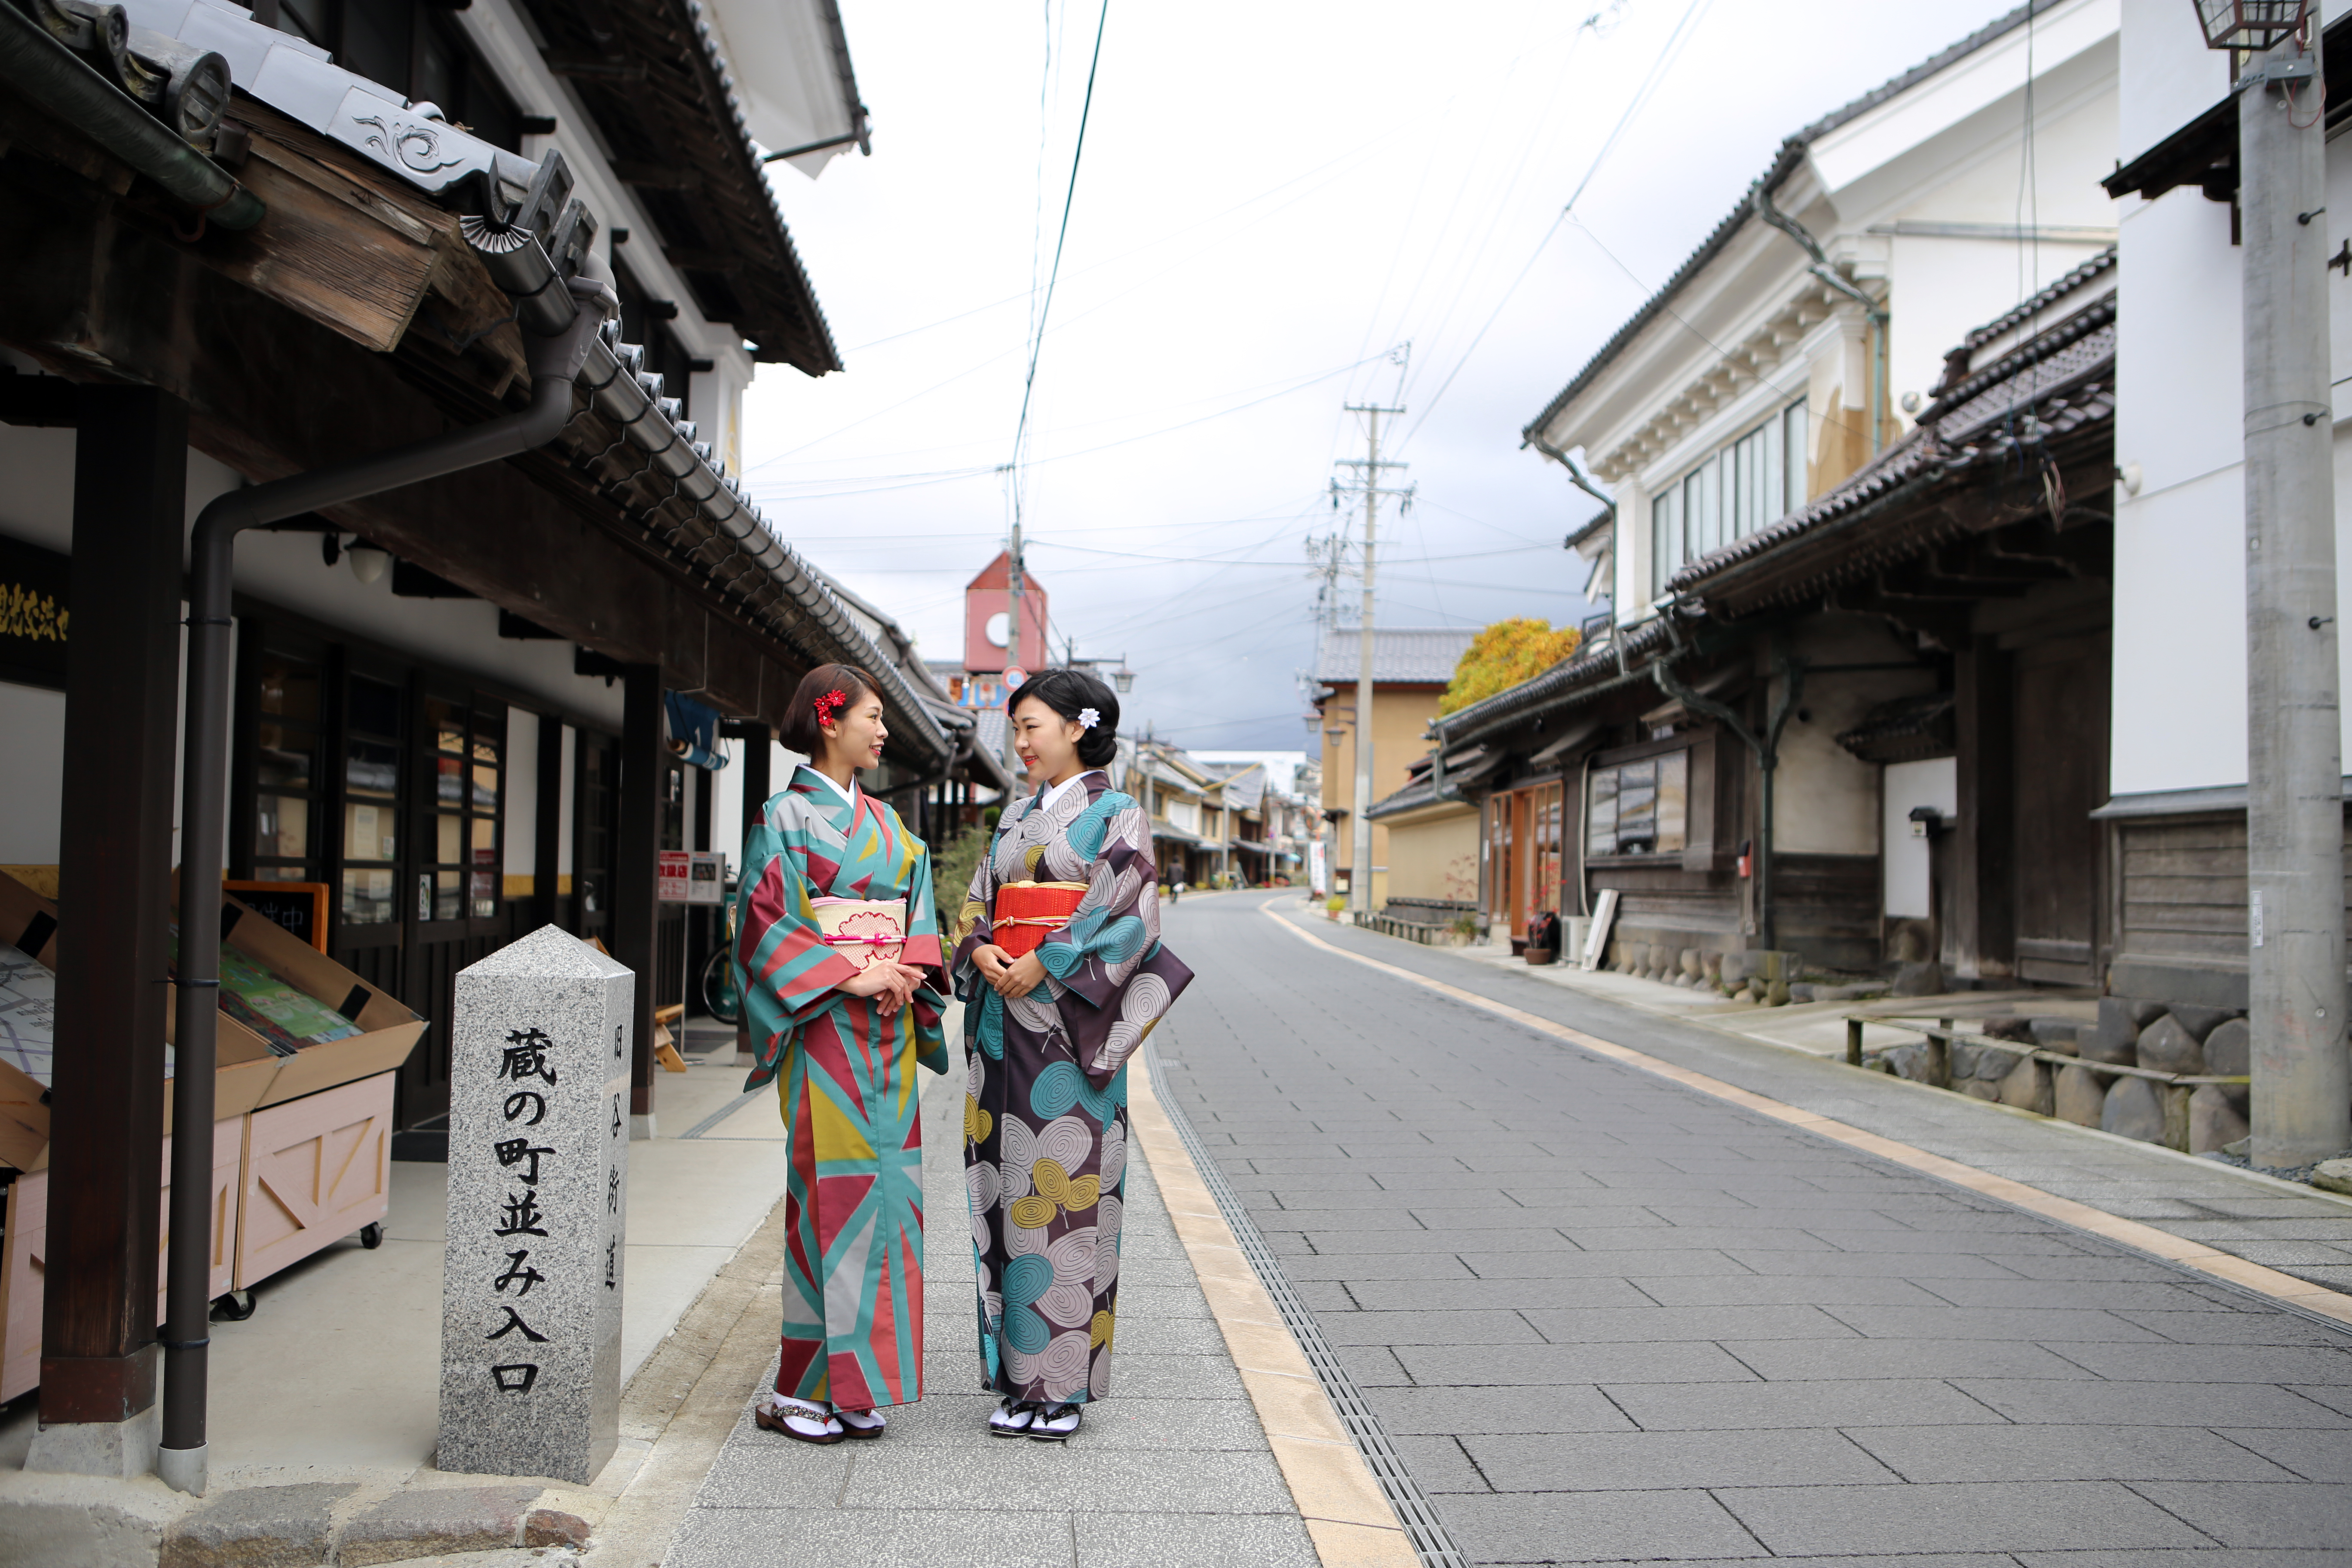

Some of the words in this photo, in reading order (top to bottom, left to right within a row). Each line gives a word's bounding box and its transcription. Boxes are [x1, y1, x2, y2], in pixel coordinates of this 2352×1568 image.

[1009, 673, 1023, 683] 40
[484, 1027, 557, 1395] 蔵の町並み入口
[605, 1024, 622, 1291] 旧谷街道
